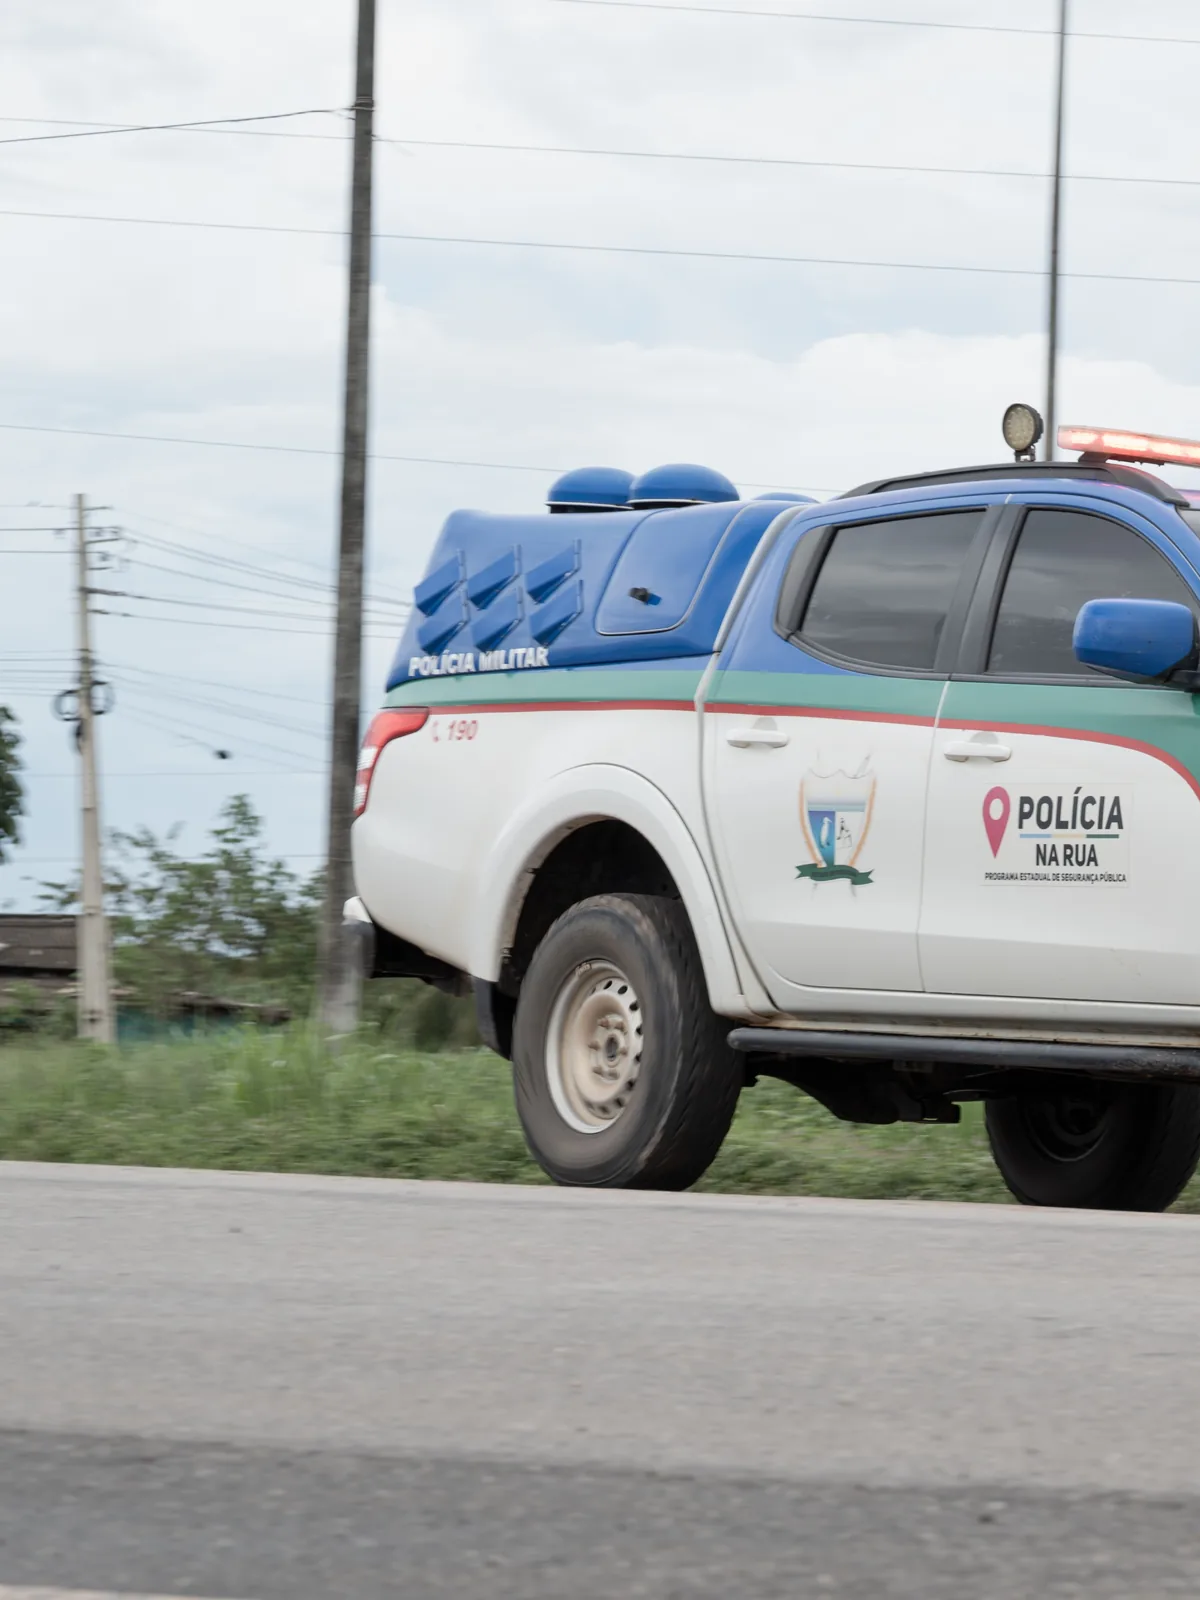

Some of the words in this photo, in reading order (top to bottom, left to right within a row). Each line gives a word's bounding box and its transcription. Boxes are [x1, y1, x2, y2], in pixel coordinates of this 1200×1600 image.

[408, 649, 476, 676] POLÍCIA
[479, 647, 549, 672] MILITAR
[448, 720, 478, 740] 190
[1018, 786, 1124, 830] POLÍCIA
[1036, 843, 1060, 867] NA
[1063, 843, 1099, 867] RUA
[985, 872, 1018, 881] PROGRAMA
[1020, 873, 1051, 881] ESTADUAL
[1052, 873, 1060, 881] DE
[1061, 873, 1098, 884] SEGURANÇA
[1099, 871, 1127, 882] PÚBLICA
